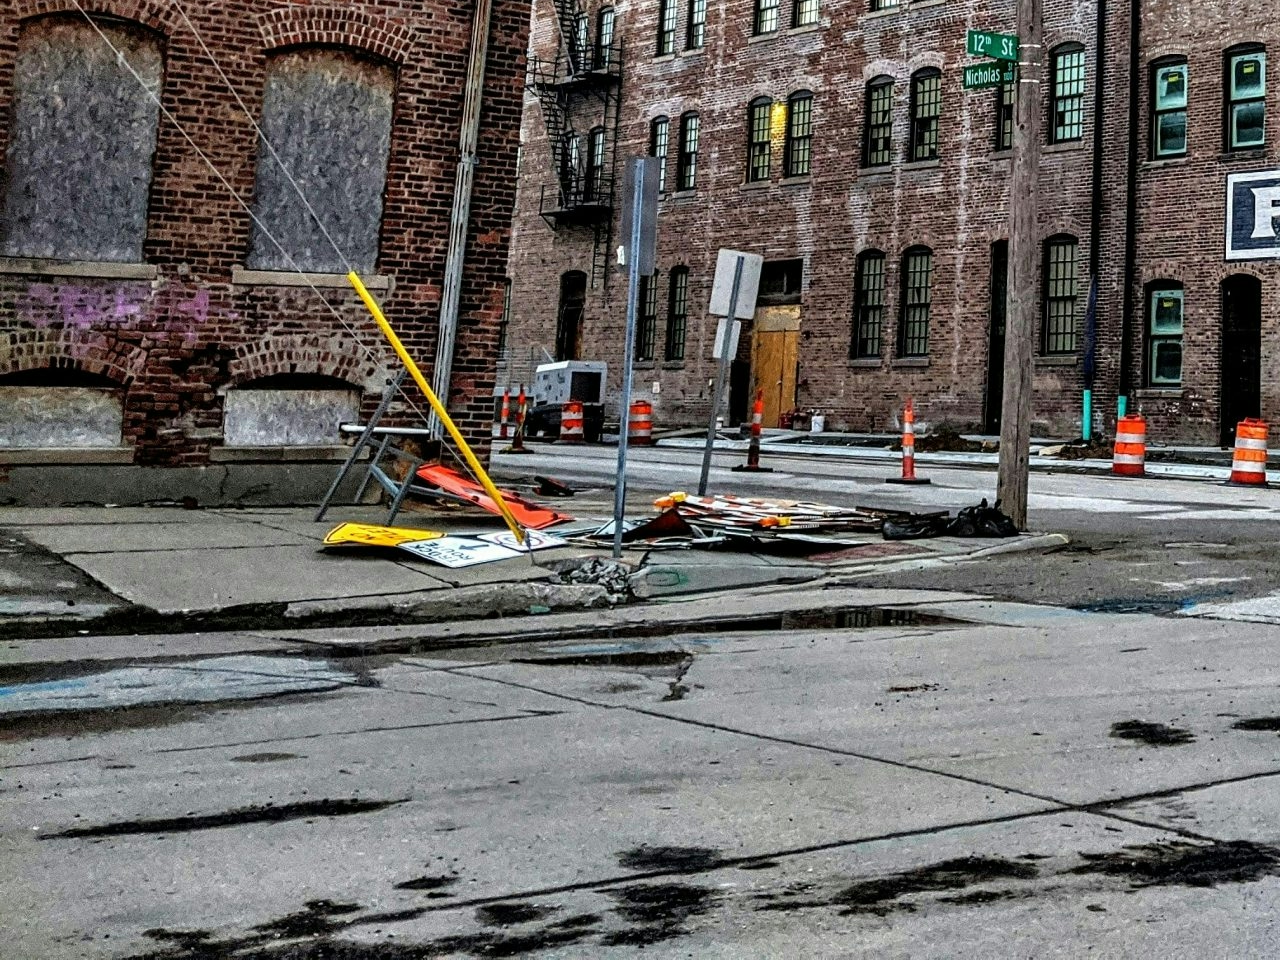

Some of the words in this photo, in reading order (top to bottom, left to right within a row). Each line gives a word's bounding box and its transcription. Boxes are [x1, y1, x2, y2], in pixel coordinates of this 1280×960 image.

[973, 34, 992, 52] 12th
[1001, 38, 1013, 56] St
[966, 67, 1001, 86] Nicholas
